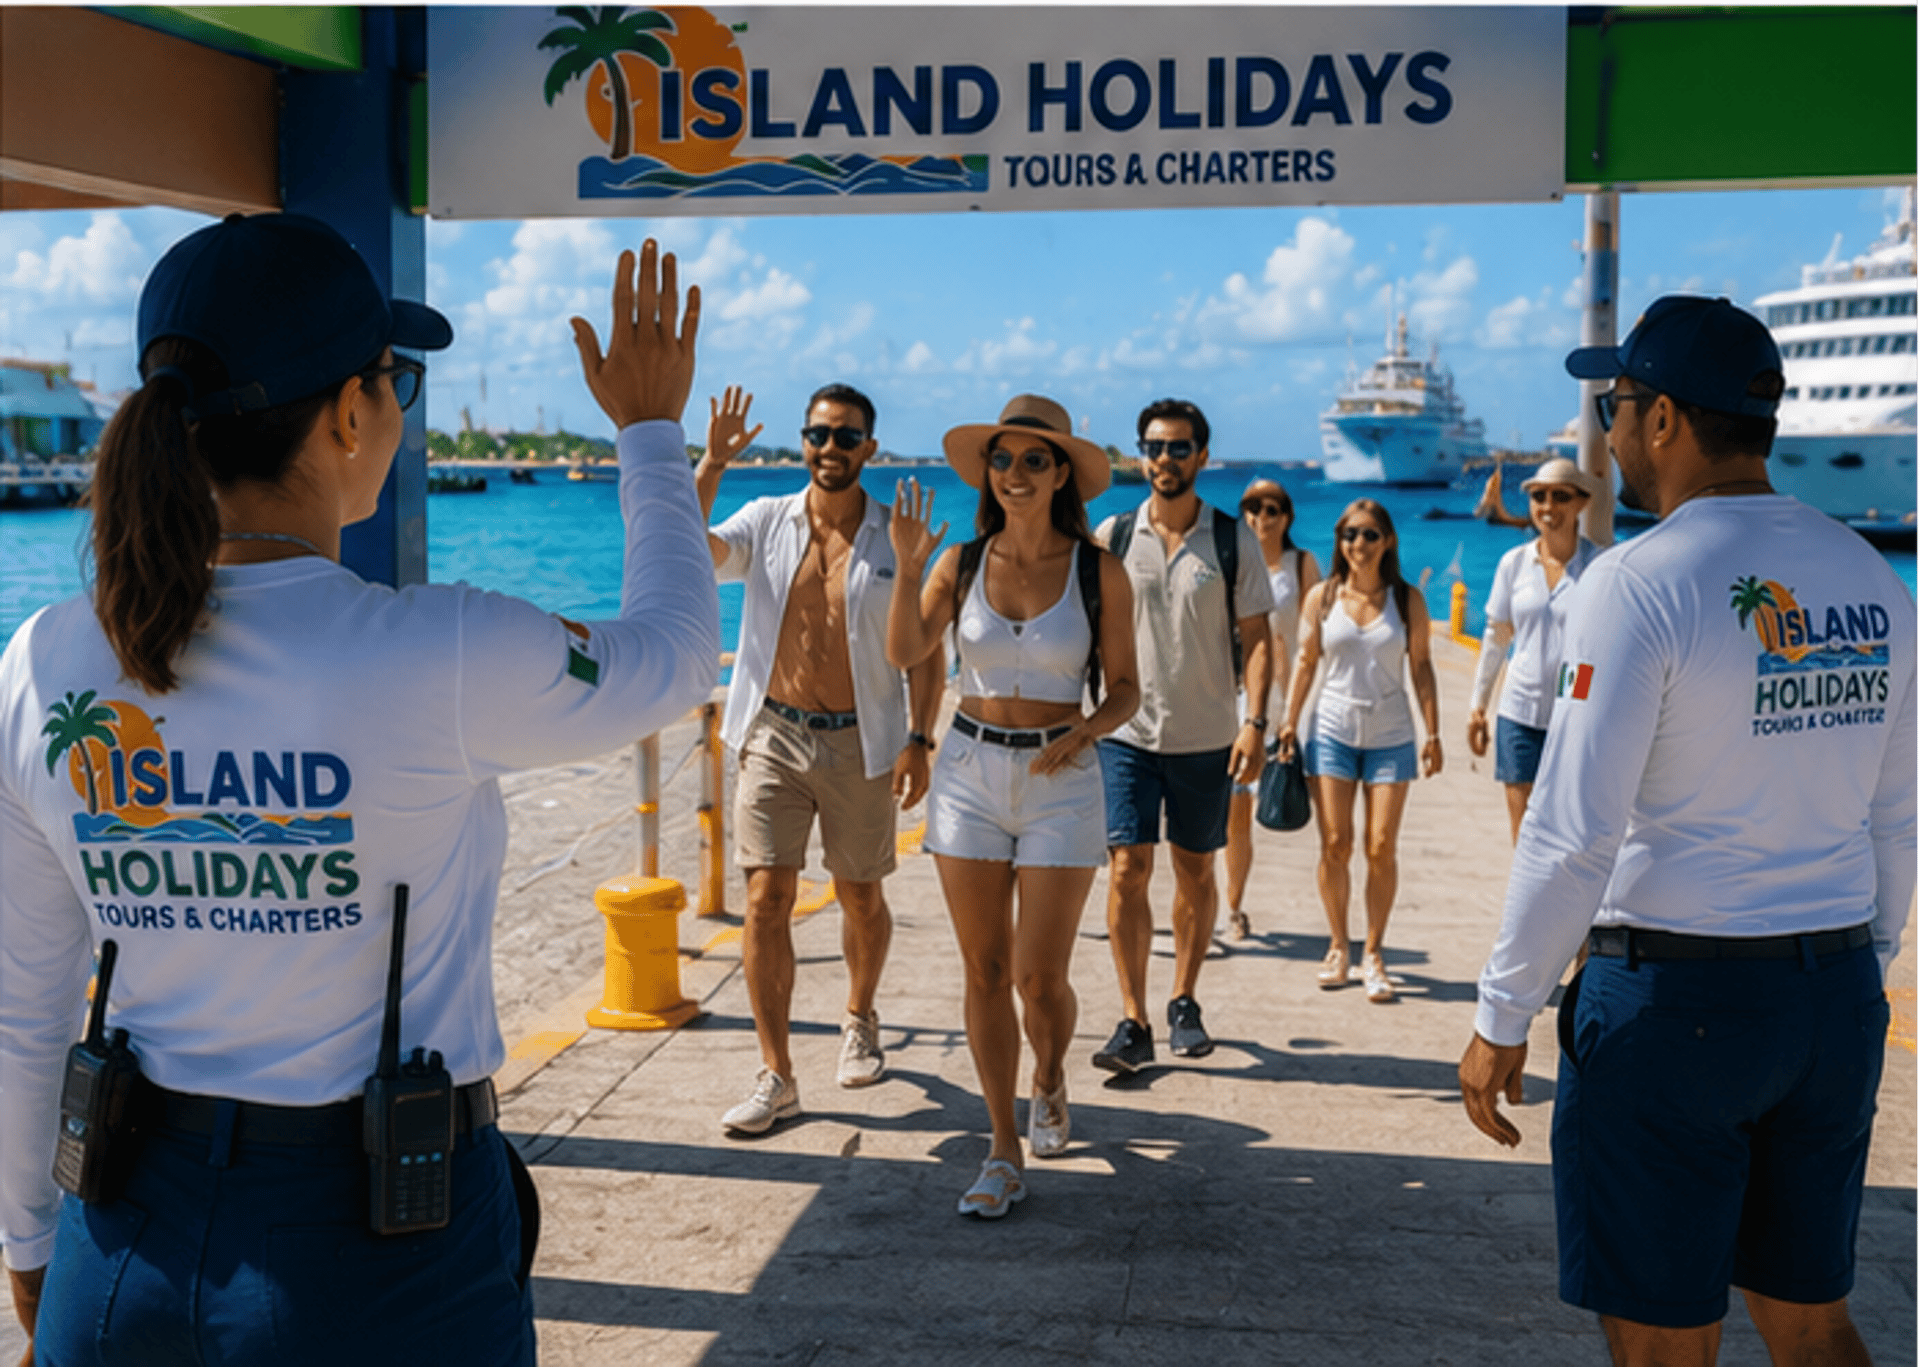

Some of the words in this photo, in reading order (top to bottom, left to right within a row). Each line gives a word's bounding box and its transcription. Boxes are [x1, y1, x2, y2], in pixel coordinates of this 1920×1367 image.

[659, 66, 1000, 141] ISLAND
[1028, 51, 1453, 133] HOLIDAYS
[1004, 154, 1117, 188] TOURS
[1156, 149, 1336, 185] CHARTERS
[1775, 604, 1890, 648] ISLAND
[1756, 670, 1889, 714] HOLIDAYS
[110, 750, 352, 808] ISLAND
[80, 850, 360, 900] HOLIDAYS
[94, 903, 176, 929] TOURS
[184, 907, 203, 929] &
[209, 902, 362, 933] CHARTERS
